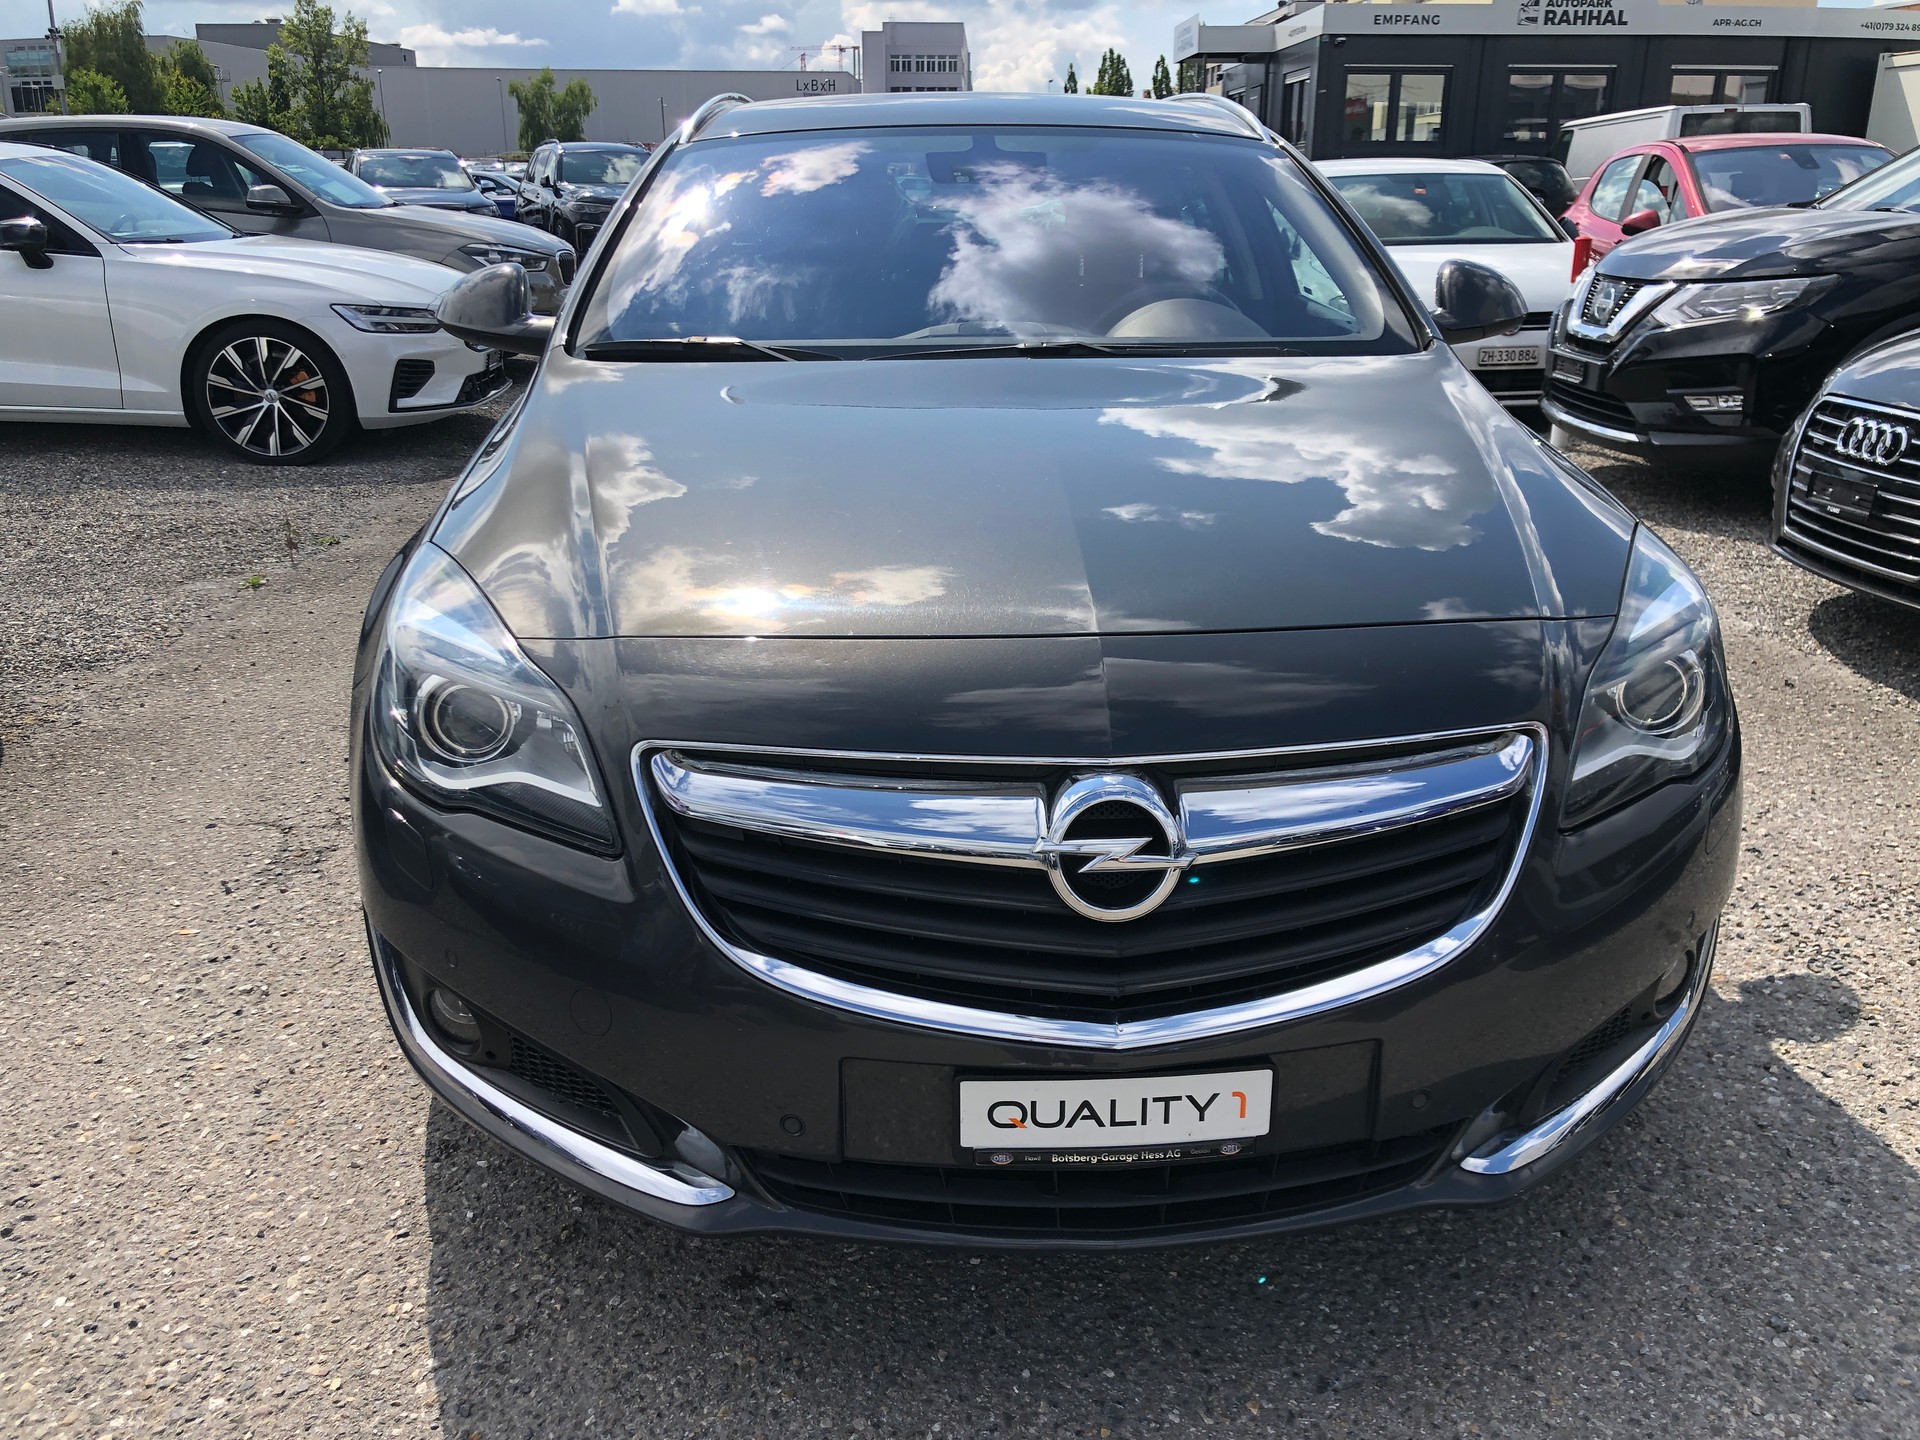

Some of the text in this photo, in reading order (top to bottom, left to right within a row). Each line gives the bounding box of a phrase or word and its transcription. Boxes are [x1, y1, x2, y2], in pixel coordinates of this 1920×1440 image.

[1374, 14, 1440, 25] EMPFANG
[1544, 9, 1629, 26] RAHHAL
[1712, 18, 1762, 27] APR-AG.CH
[987, 1093, 1220, 1129] QUALITY
[1051, 1151, 1139, 1164] Botsberg-Garage
[1141, 1151, 1164, 1160] Hess
[1166, 1149, 1181, 1158] AG
